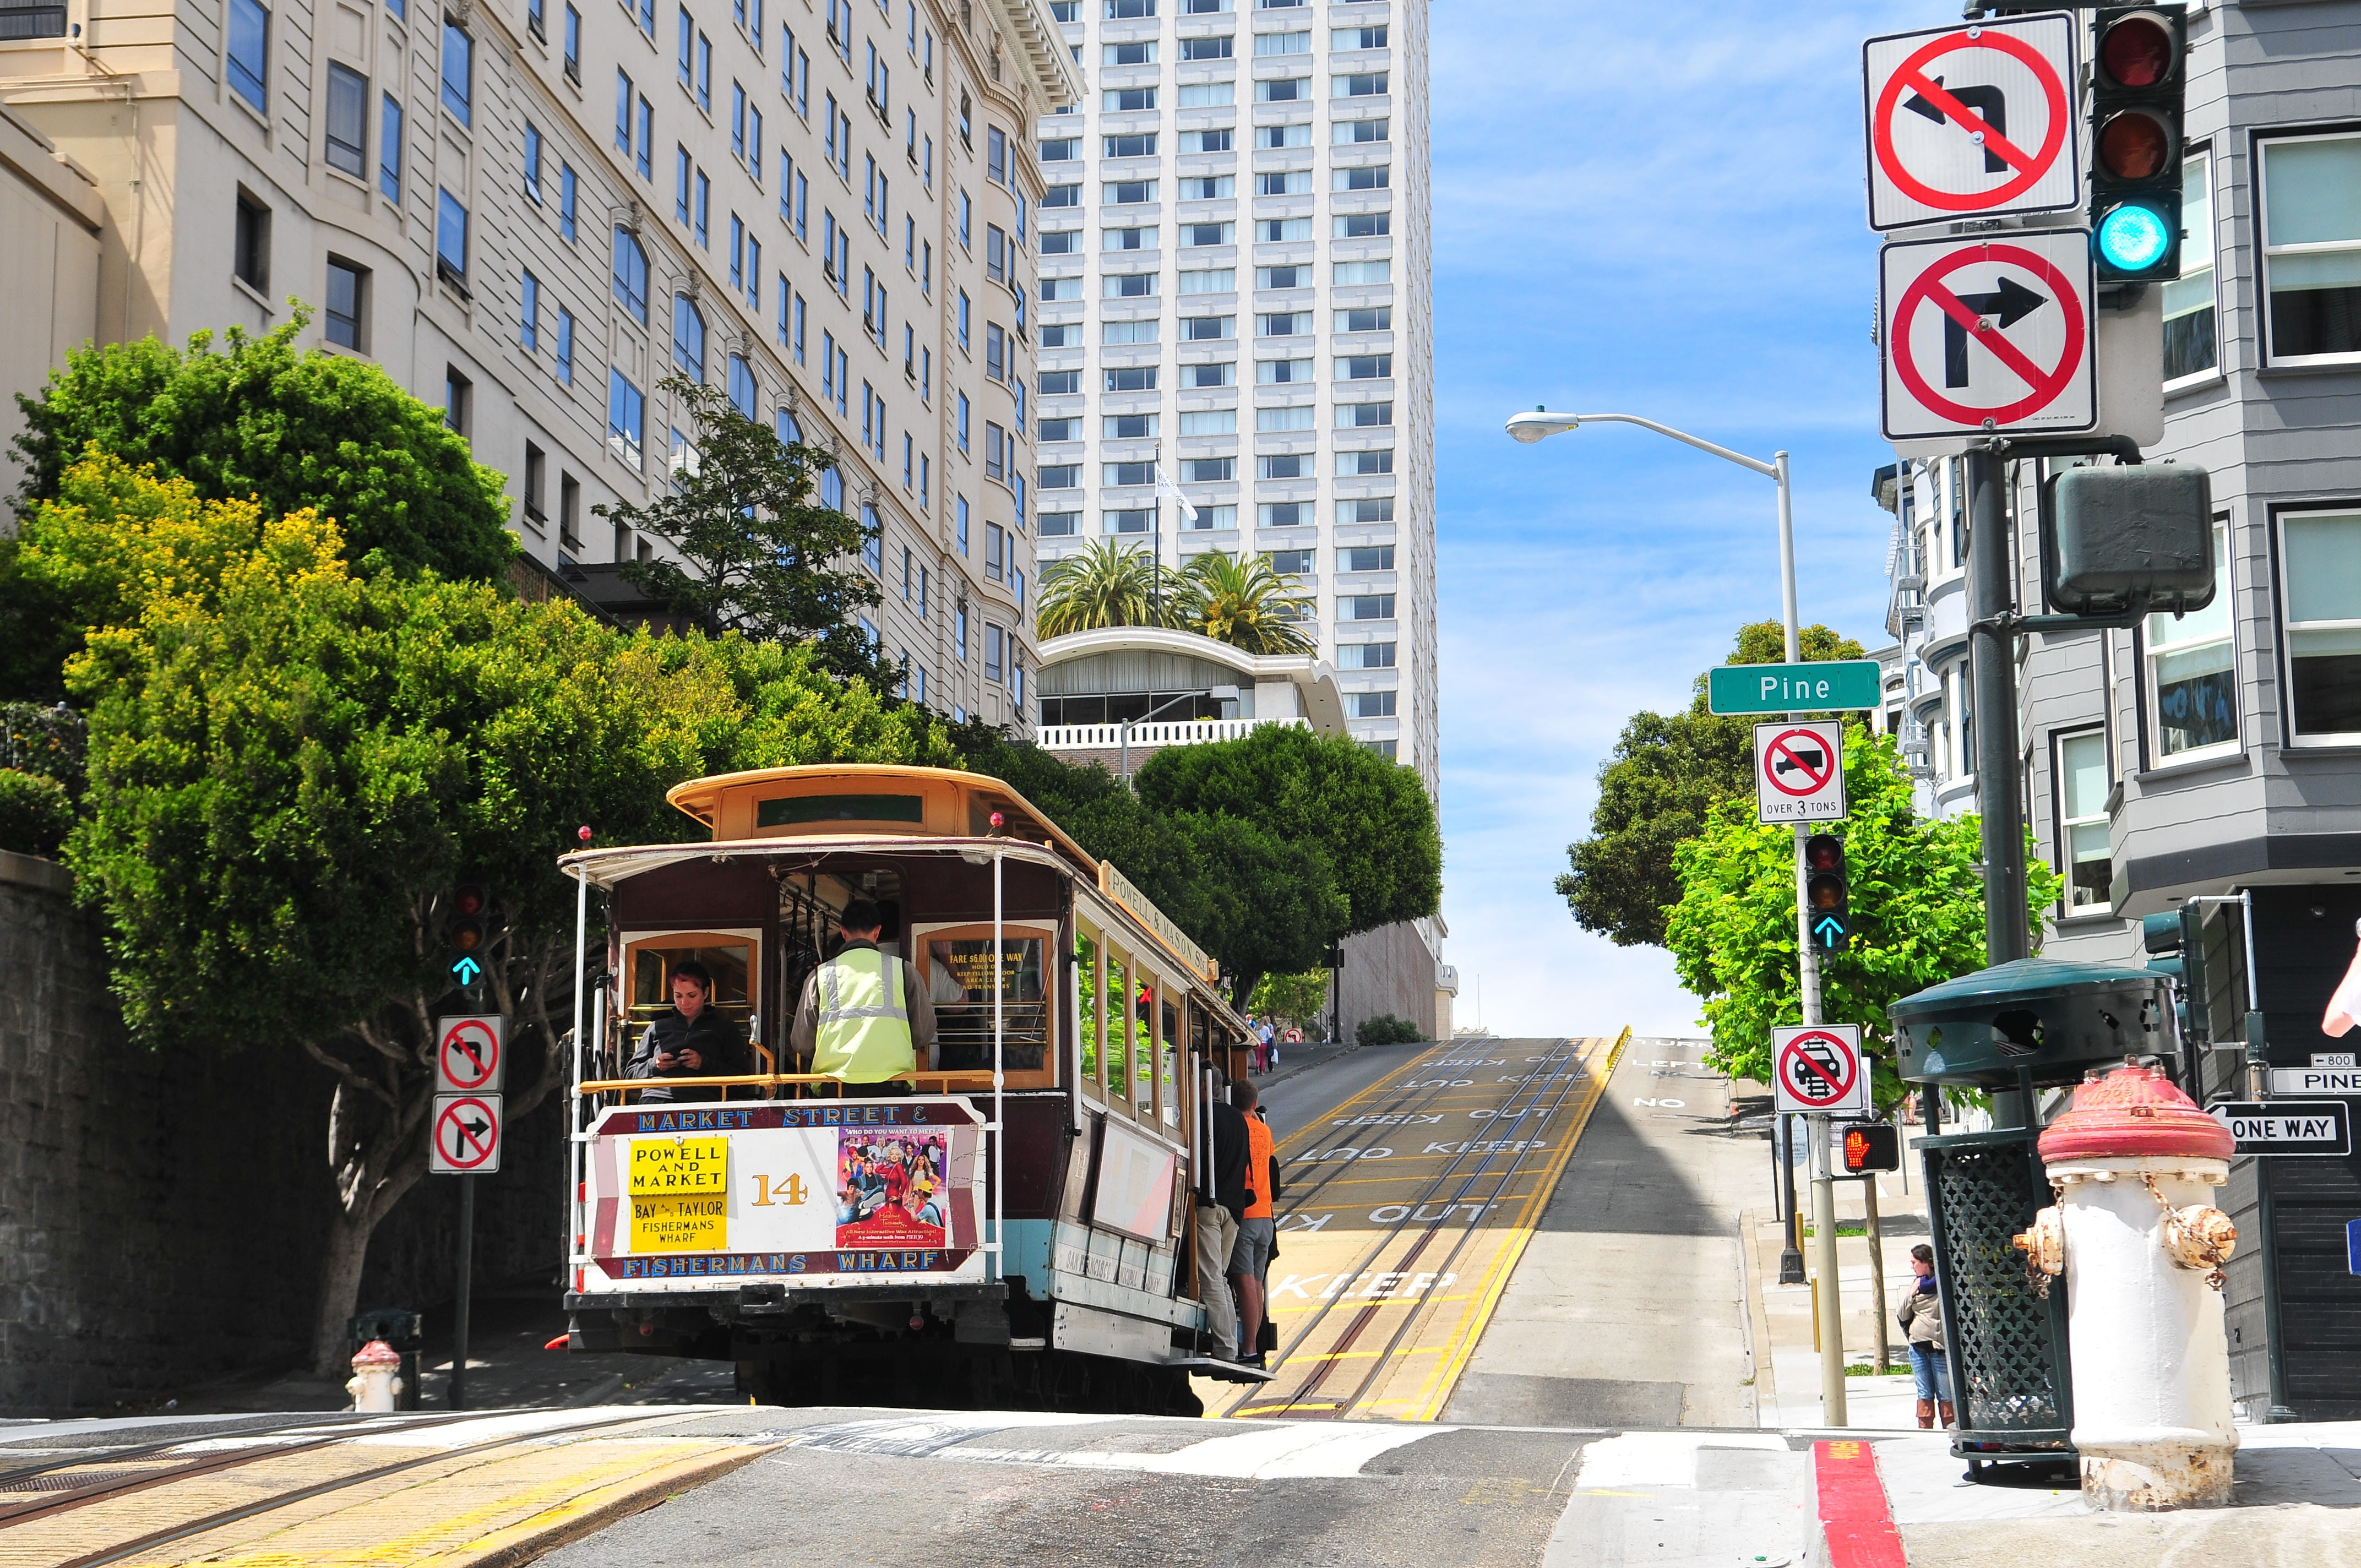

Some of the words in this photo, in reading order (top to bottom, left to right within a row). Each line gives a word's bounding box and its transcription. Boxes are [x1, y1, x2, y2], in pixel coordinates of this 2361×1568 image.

[1761, 677, 1830, 700] Pine
[1767, 803, 1792, 814] OVER
[1797, 800, 1806, 817] 3
[1810, 802, 1836, 812] TONS
[1112, 872, 1150, 923] POWELL
[1154, 912, 1160, 932] &
[1163, 919, 1193, 961] MASON
[950, 955, 967, 963] FARE
[970, 954, 986, 962] $6.00
[988, 954, 1004, 962] OE
[1006, 953, 1022, 962] WAY
[1635, 1038, 1713, 1048] TURN
[1631, 1059, 1709, 1070] LEFT
[2328, 1055, 2351, 1065] 800
[1395, 1079, 1474, 1088] OUT
[1496, 1073, 1589, 1082] KEEP
[2304, 1074, 2361, 1088] PINE
[1633, 1097, 1686, 1108] NO
[638, 1109, 753, 1133] MARKET
[783, 1106, 902, 1127] STREET
[1332, 1114, 1445, 1125] KEEP
[1468, 1108, 1558, 1118] OUT
[2232, 1120, 2277, 1138] ONE
[2284, 1119, 2330, 1137] WAY
[1422, 1140, 1546, 1153] KEEP
[636, 1147, 721, 1162] POWELL
[1286, 1147, 1394, 1161] OUT
[658, 1162, 700, 1173] AND
[633, 1173, 721, 1188] MARKET
[751, 1172, 808, 1206] 14
[635, 1204, 656, 1219] BAY
[661, 1204, 674, 1217] AND
[677, 1201, 723, 1217] TAYLOR
[1368, 1204, 1498, 1223] OUT
[643, 1220, 714, 1233] FISHERMANS
[659, 1233, 696, 1243] WHARF
[622, 1254, 807, 1277] FISHERMANS
[837, 1251, 938, 1272] WHARF
[1066, 1250, 1079, 1270] SAN
[1269, 1271, 1459, 1299] KEEP
